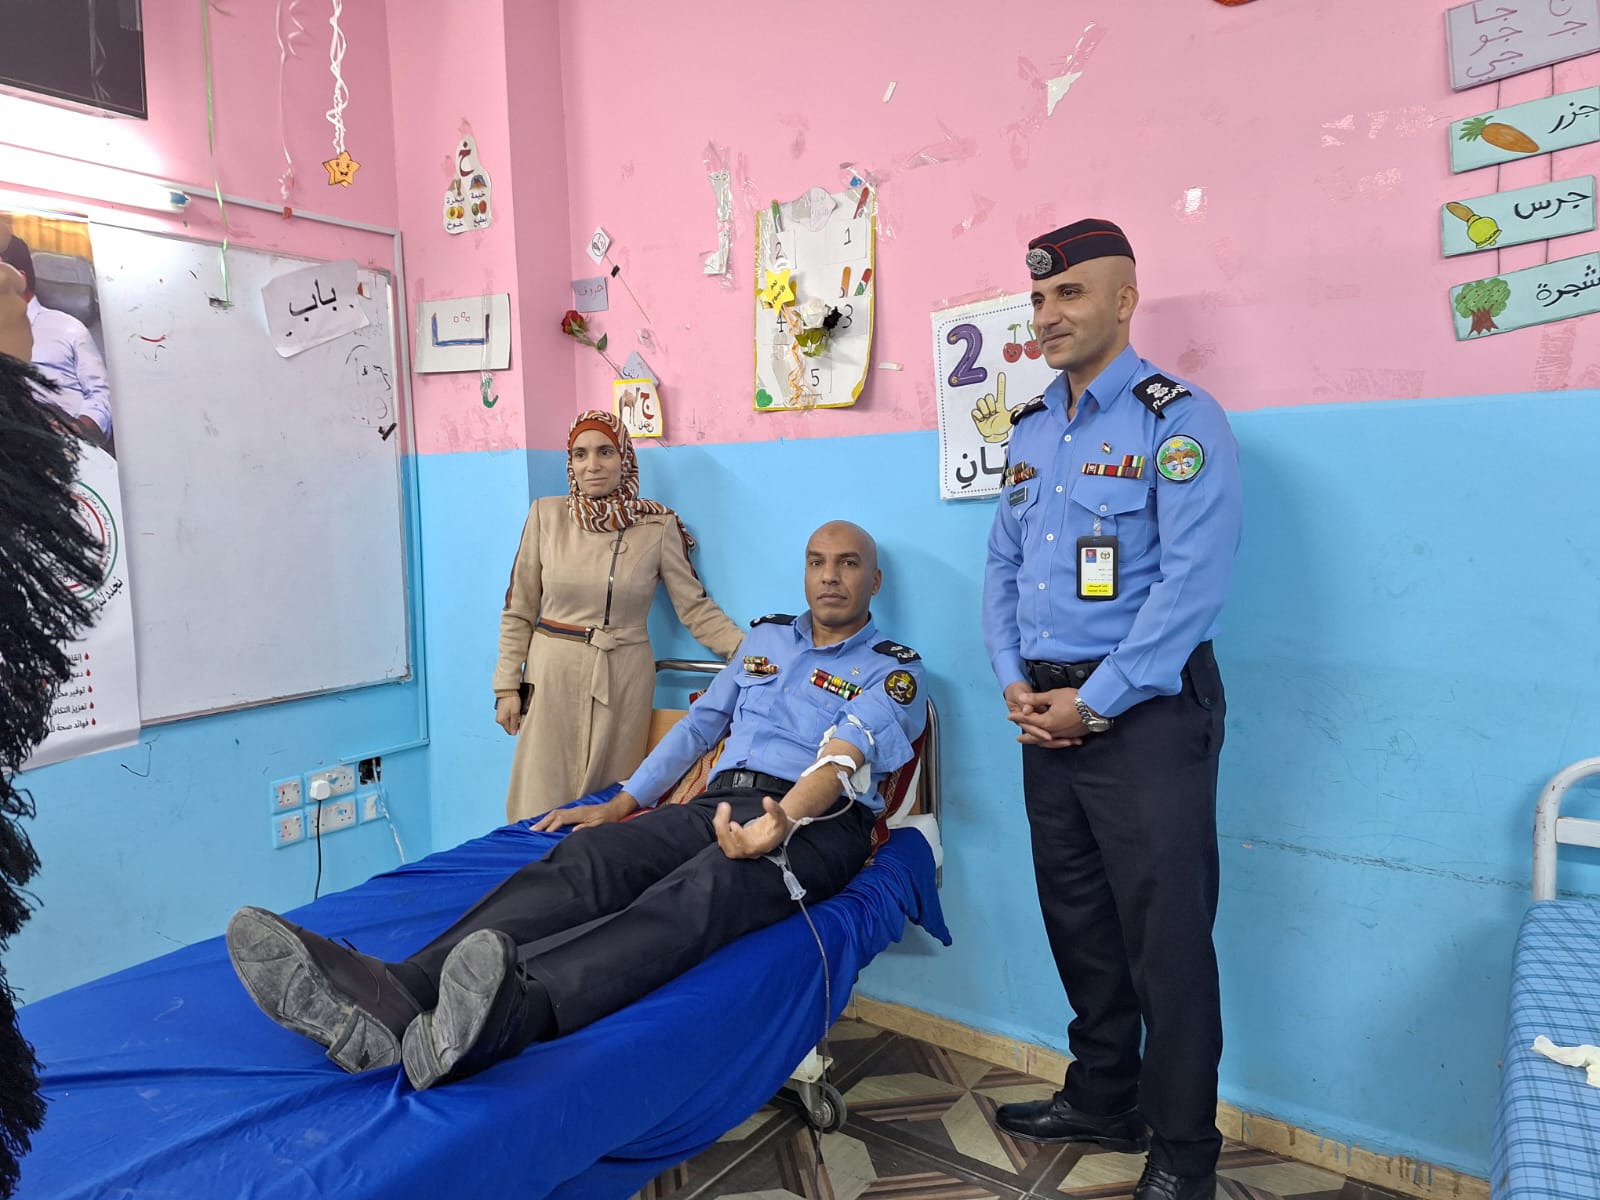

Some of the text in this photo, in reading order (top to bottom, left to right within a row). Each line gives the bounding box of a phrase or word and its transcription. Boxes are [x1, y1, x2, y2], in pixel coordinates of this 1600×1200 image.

[1548, 102, 1600, 134] جزر
[1513, 191, 1592, 220] جرس
[843, 227, 852, 245] 1
[775, 241, 785, 260] 2
[1536, 264, 1600, 308] شجرة
[289, 279, 337, 323] باب
[776, 310, 787, 333] 4
[844, 303, 854, 329] 3
[947, 323, 988, 388] 2
[810, 368, 821, 387] 5
